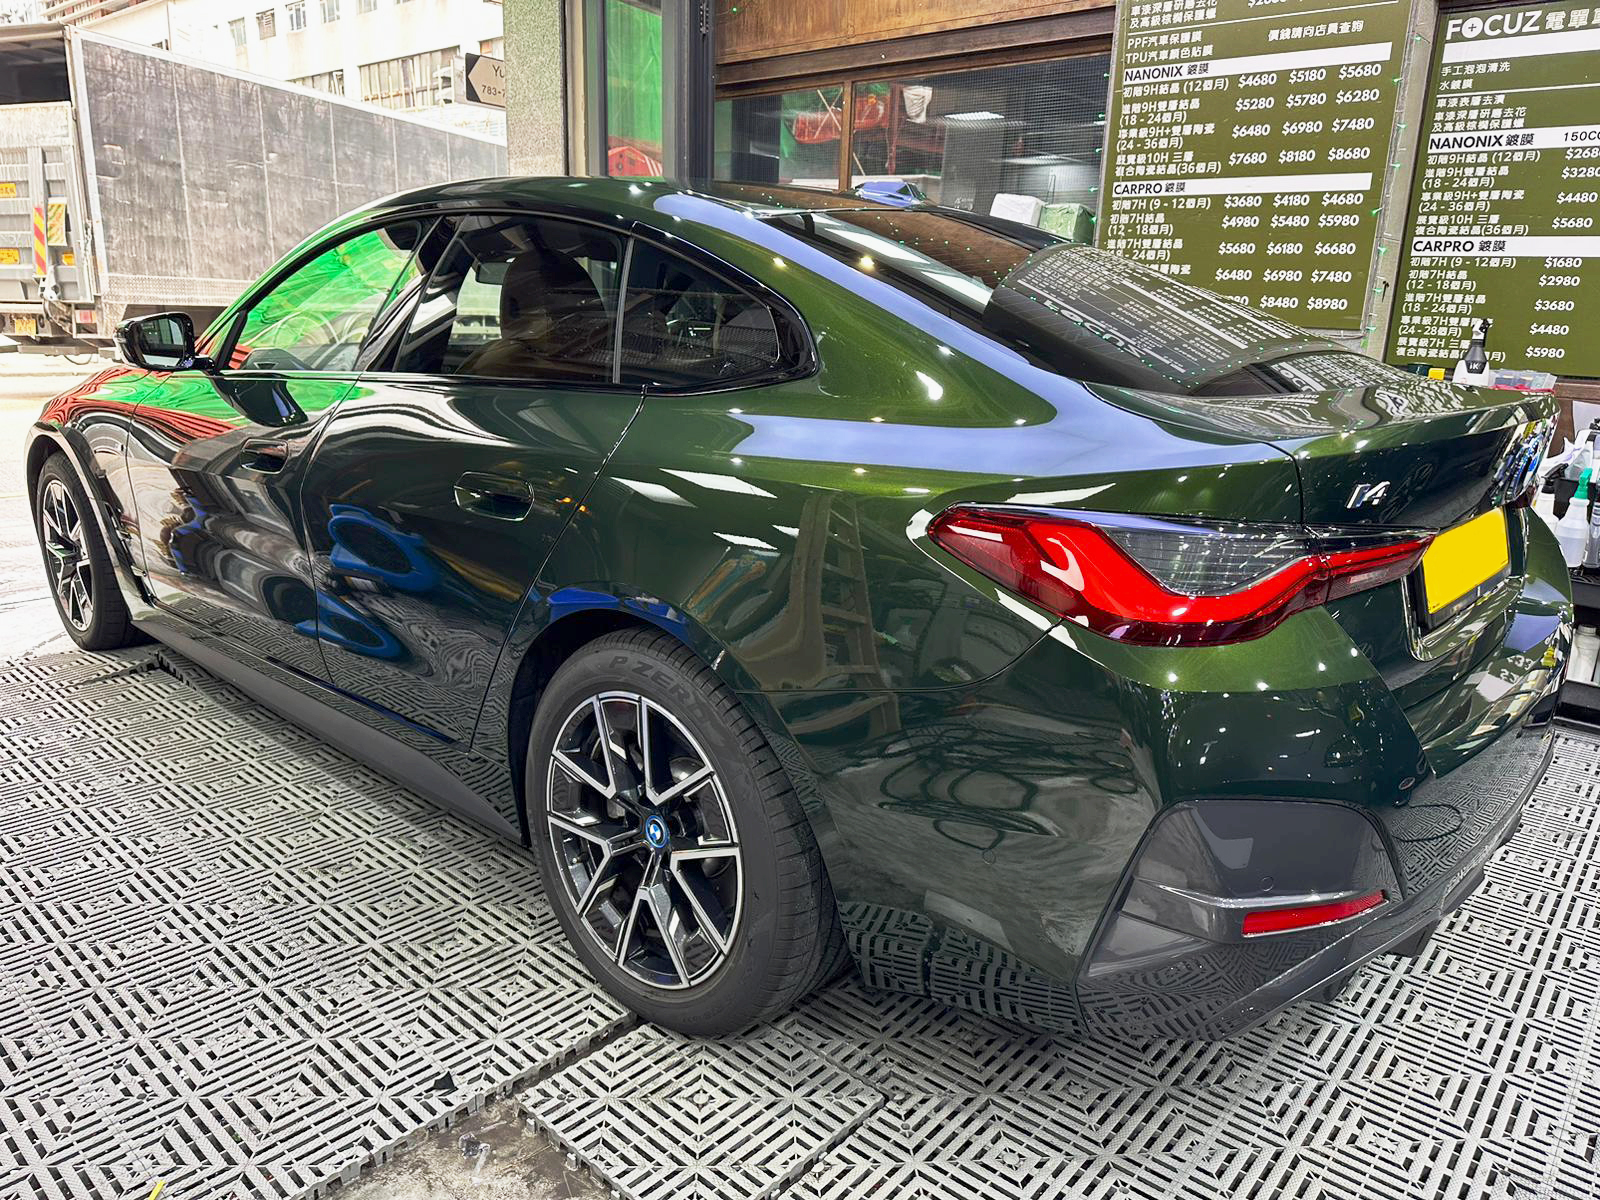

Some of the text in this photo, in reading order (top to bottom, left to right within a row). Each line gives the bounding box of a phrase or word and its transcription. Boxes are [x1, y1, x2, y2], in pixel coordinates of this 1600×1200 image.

[1445, 10, 1542, 40] FOCUZ
[1124, 65, 1183, 81] NANONIX
[1238, 63, 1381, 88] $4680 $5180 $5680
[1441, 62, 1510, 76] 手工泡泡清洗
[1183, 78, 1229, 94] (12個月)
[1439, 79, 1473, 90] 水鍍膜
[1235, 88, 1379, 112] $5280 $5780 $6280
[1119, 115, 1137, 127] (18
[1147, 111, 1187, 124] 24個月)
[1232, 117, 1374, 138] $6480 $6980 $7480
[1116, 140, 1134, 152] (24
[1144, 137, 1183, 149] 36個月)
[1430, 135, 1503, 149] NANONIX
[1505, 133, 1535, 147] 鍍膜
[1228, 147, 1370, 166] $7680 $8180 $8680
[1491, 150, 1541, 164] (12個月)
[1565, 147, 1600, 160] $268
[1113, 183, 1162, 195] CARPRO
[1422, 178, 1441, 189] (18
[1452, 177, 1495, 188] 24個月)
[1149, 198, 1161, 211] (9
[1172, 197, 1211, 210] 12個月)
[1224, 192, 1364, 208] $3680 $4180 $4680
[1556, 191, 1598, 204] $4480
[1418, 202, 1437, 213] (24
[1448, 201, 1490, 212] 36個月)
[1221, 213, 1359, 229] $4980 $5480 $5980
[1552, 217, 1593, 229] $5680
[1107, 225, 1125, 236] (12
[1136, 224, 1173, 236] 18個月)
[1218, 242, 1356, 256] $5680 $6180 $6680
[1413, 240, 1507, 252] CARPRO 鍍膜
[1132, 250, 1171, 261] 24個月)
[1450, 257, 1463, 269] (9
[1475, 257, 1516, 269] 12個月)
[1544, 256, 1582, 269] $1680
[1215, 268, 1352, 283] $6480 $6980 $7480
[1538, 275, 1580, 287] $2980
[1406, 280, 1424, 291] (12
[1436, 280, 1477, 291] 18個月)
[1260, 295, 1298, 309] $8480
[1307, 296, 1348, 311] $8980
[1402, 303, 1420, 313] (18
[1431, 304, 1472, 315] 24個月)
[1534, 299, 1574, 312] $3680
[1398, 325, 1415, 335] (24
[1423, 326, 1462, 337] 28個月)
[1529, 323, 1569, 336] $4480
[1525, 346, 1565, 359] $5980
[609, 655, 630, 669] P
